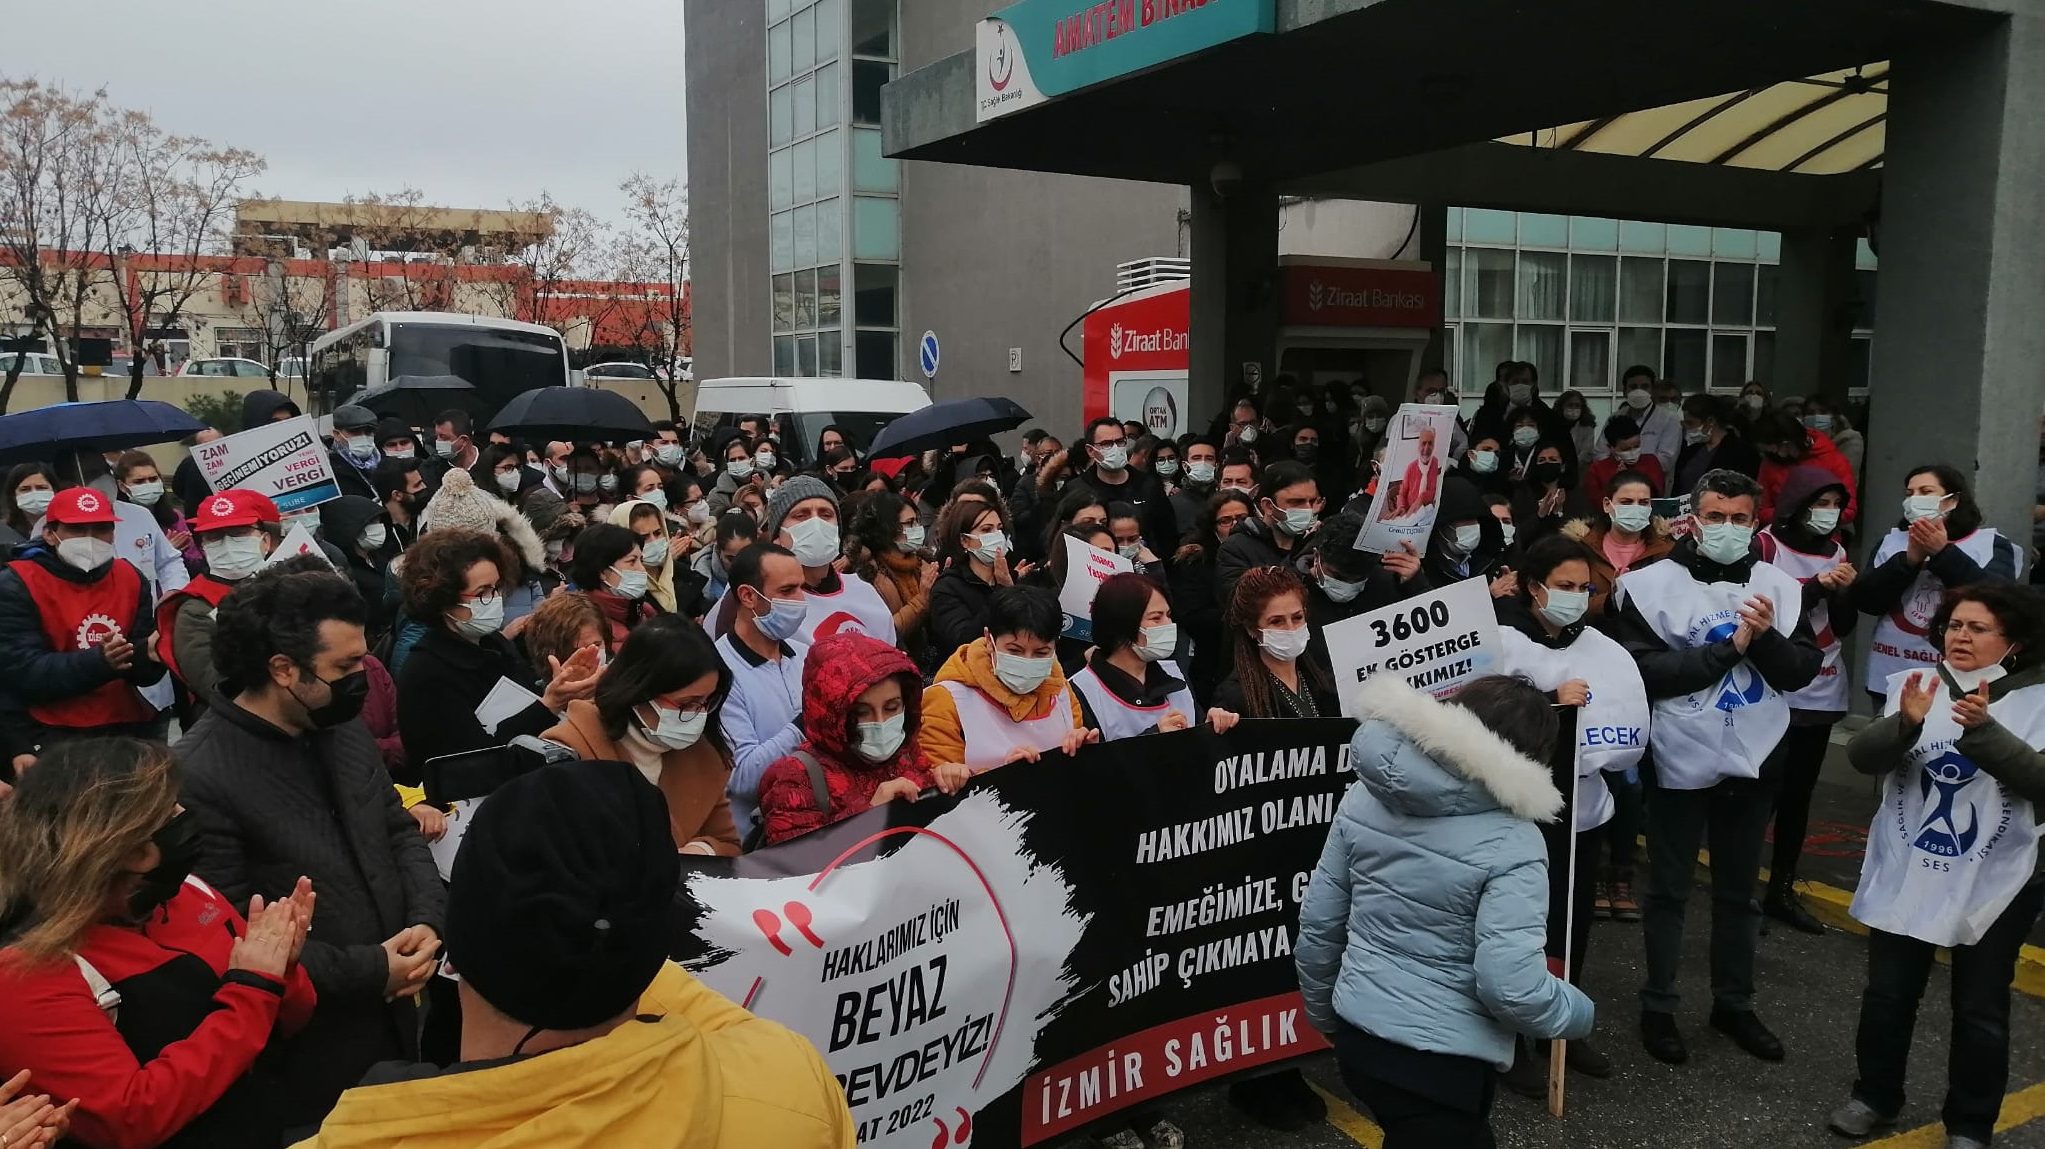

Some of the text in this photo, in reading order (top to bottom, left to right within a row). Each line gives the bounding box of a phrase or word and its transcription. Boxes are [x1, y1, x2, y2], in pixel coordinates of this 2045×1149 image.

[1053, 0, 1136, 60] AMATEM
[1326, 286, 1425, 310] Ziraat Bankası
[1124, 327, 1161, 353] Ziraat
[1149, 415, 1167, 428] ATM
[201, 443, 229, 461] ZAM
[205, 459, 224, 471] ZAM
[285, 454, 321, 473] VERGİ
[272, 464, 326, 491] VERGİ
[1370, 600, 1450, 648] 3600
[1385, 630, 1481, 672] GÖSTERGE
[1214, 745, 1326, 794] OYALAMA
[1136, 792, 1334, 864] HAKKIMIZ OLANI
[1924, 840, 1954, 855] 1996
[1922, 857, 1950, 873] SES
[1146, 876, 1283, 938] EMEĞİMİZE,
[821, 897, 961, 984] HAKLARIMIZ İÇİN
[1107, 925, 1291, 1009] SAHİP ÇIKMAYA
[828, 954, 948, 1054] BEYAZ
[1042, 1008, 1299, 1126] İZMİR SAĞLIK
[886, 1093, 935, 1136] 2022
